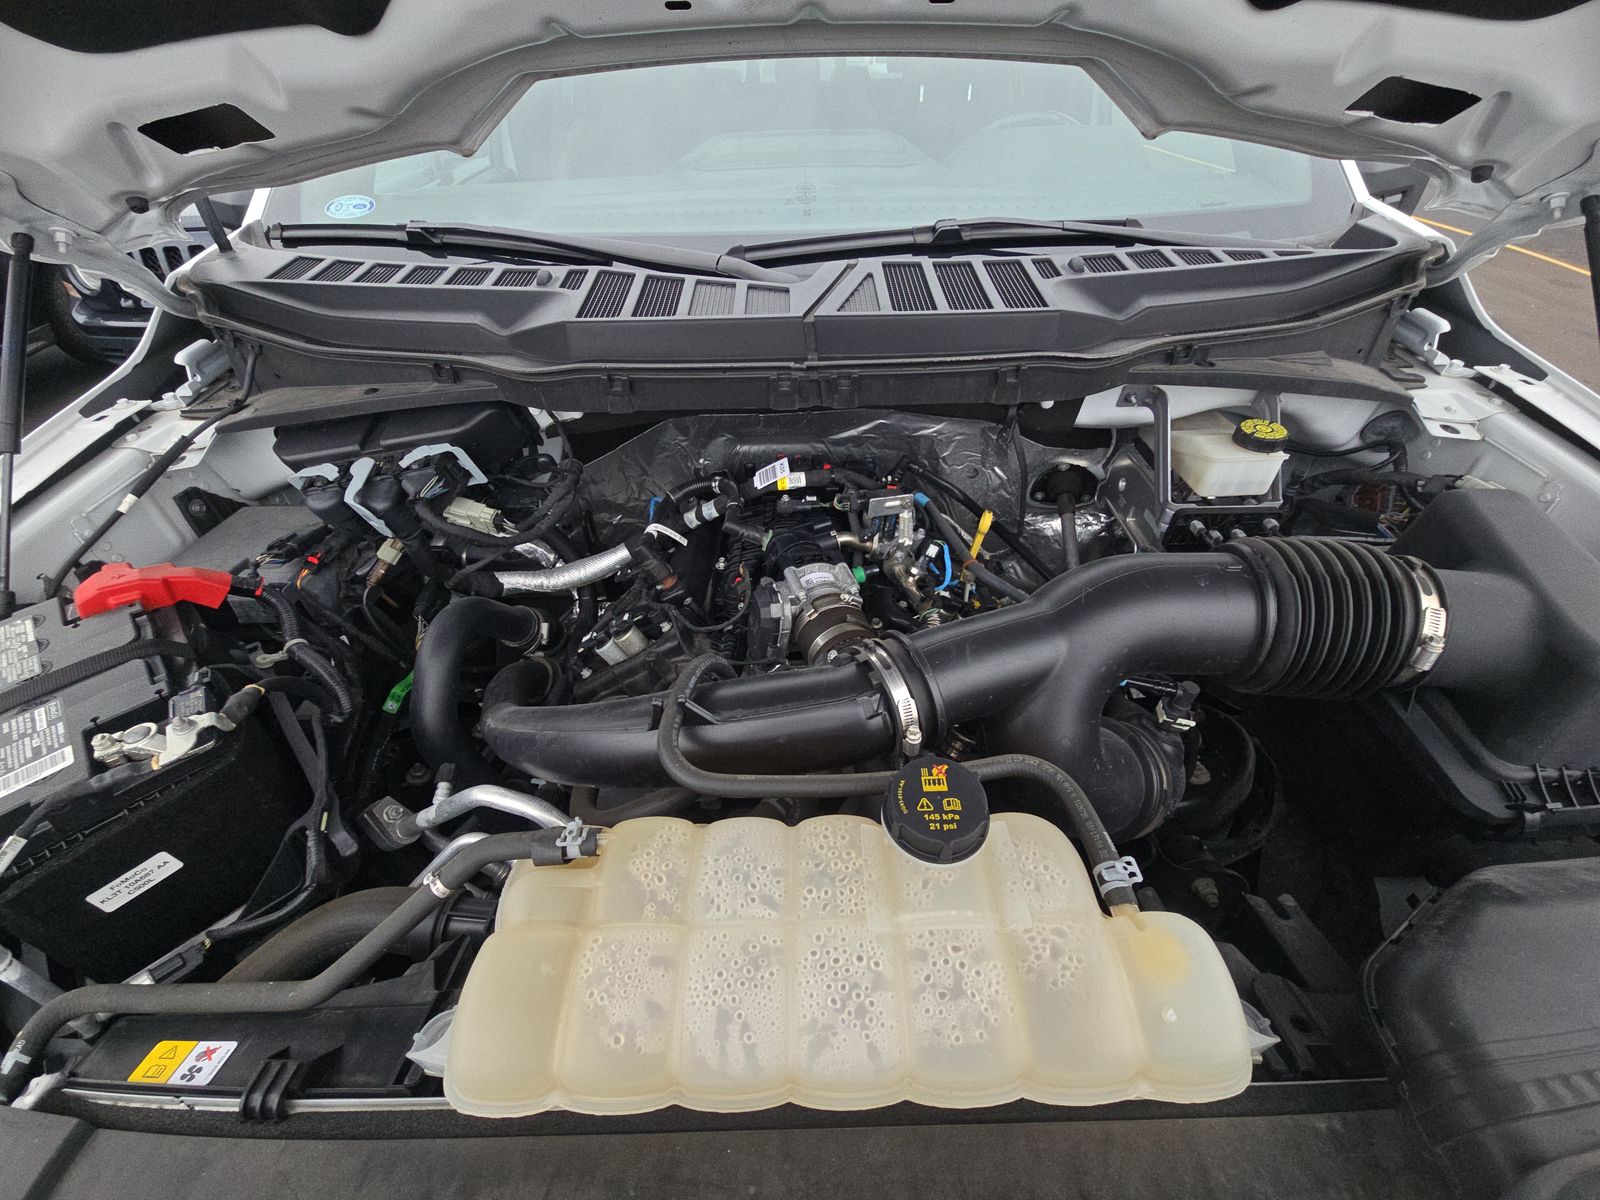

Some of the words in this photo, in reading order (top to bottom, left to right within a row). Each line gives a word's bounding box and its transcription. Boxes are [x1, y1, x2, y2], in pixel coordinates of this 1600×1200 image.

[923, 813, 941, 821] 145
[942, 813, 960, 821] kPa
[943, 823, 957, 831] psi
[156, 860, 171, 870] AA
[109, 867, 148, 891] FoMoCo
[128, 877, 156, 895] C500L
